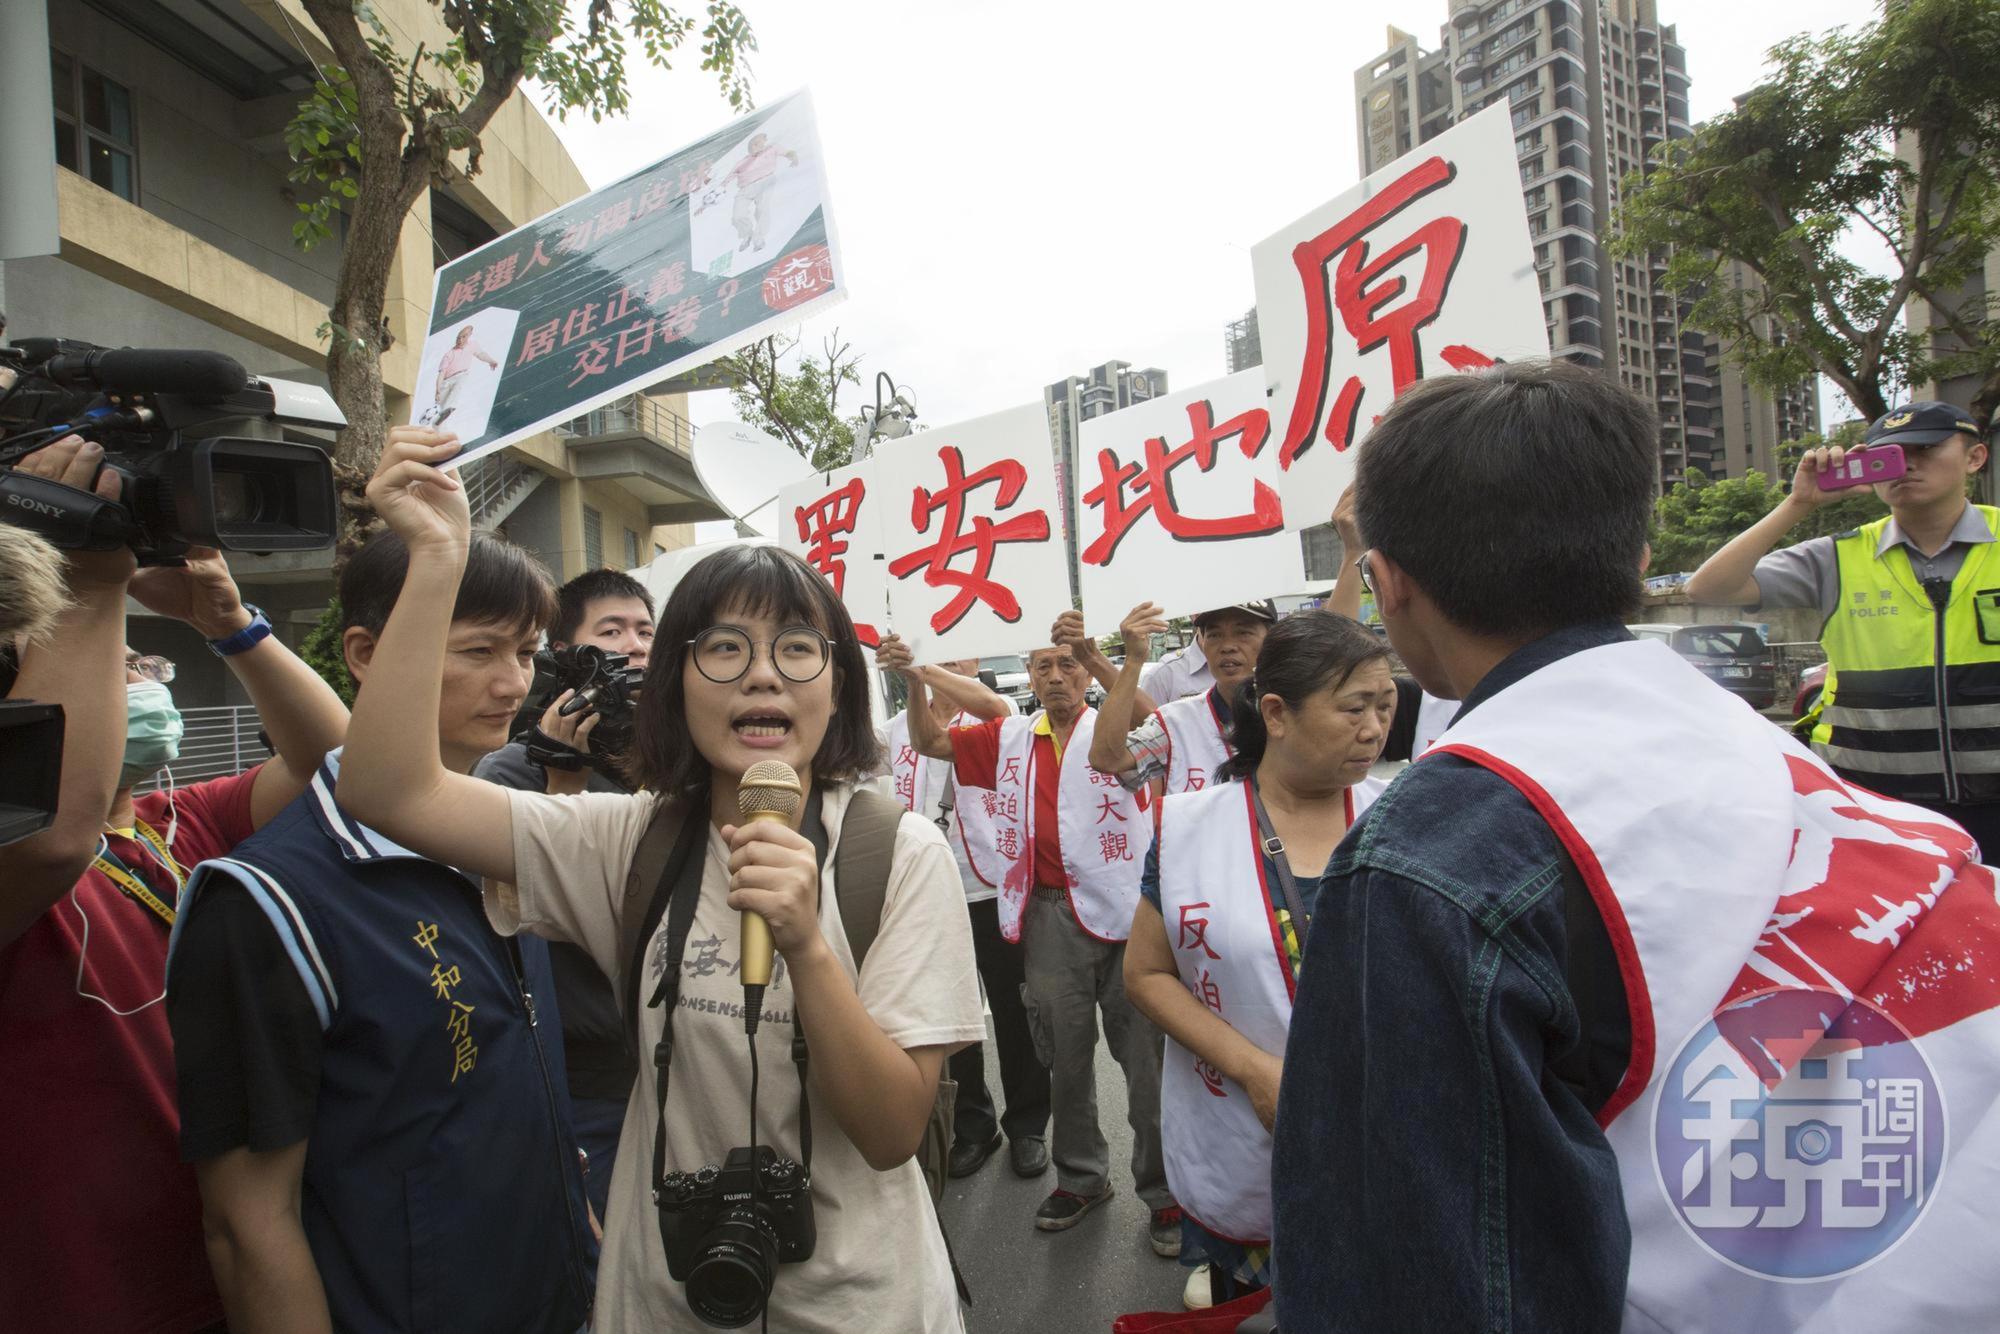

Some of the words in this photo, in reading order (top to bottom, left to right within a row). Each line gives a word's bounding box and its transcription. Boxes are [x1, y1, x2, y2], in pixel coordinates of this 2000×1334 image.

[516, 261, 687, 367] 居住正義
[780, 256, 815, 297] 大觀
[1279, 156, 1506, 472] 原
[8, 494, 66, 518] SONY
[1082, 400, 1283, 567] 地
[888, 445, 1050, 636] 安
[1849, 606, 1898, 617] POLICE
[894, 744, 916, 812] 反迫
[997, 757, 1021, 861] 反迫遷
[412, 920, 479, 1083] 中和分局
